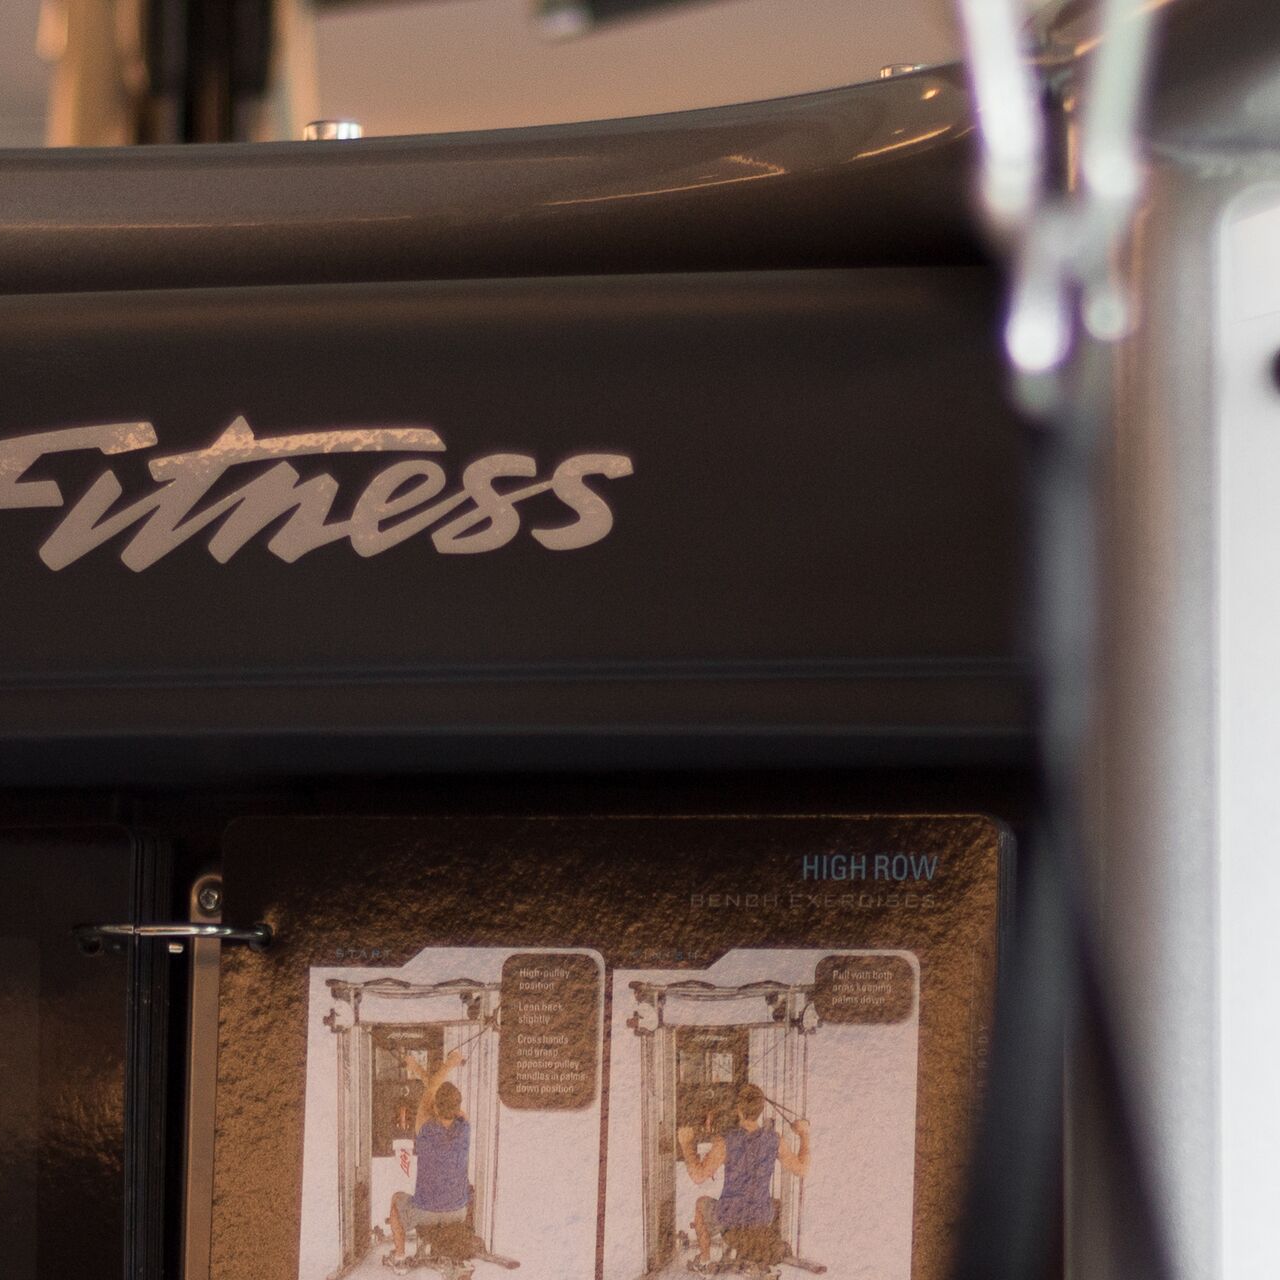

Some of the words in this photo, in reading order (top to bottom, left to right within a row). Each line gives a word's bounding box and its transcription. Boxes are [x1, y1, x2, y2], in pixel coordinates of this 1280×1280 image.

[801, 855, 866, 881] HIGH
[873, 854, 939, 881] ROW
[690, 893, 778, 908] BENCH
[790, 893, 936, 908] EXERCISES
[517, 1034, 542, 1044] Cross
[543, 1034, 569, 1044] hands
[516, 1047, 535, 1056] and
[516, 1060, 554, 1070] opposite
[516, 1071, 549, 1082] handles
[516, 1084, 539, 1093] down
[540, 1084, 574, 1095] position
